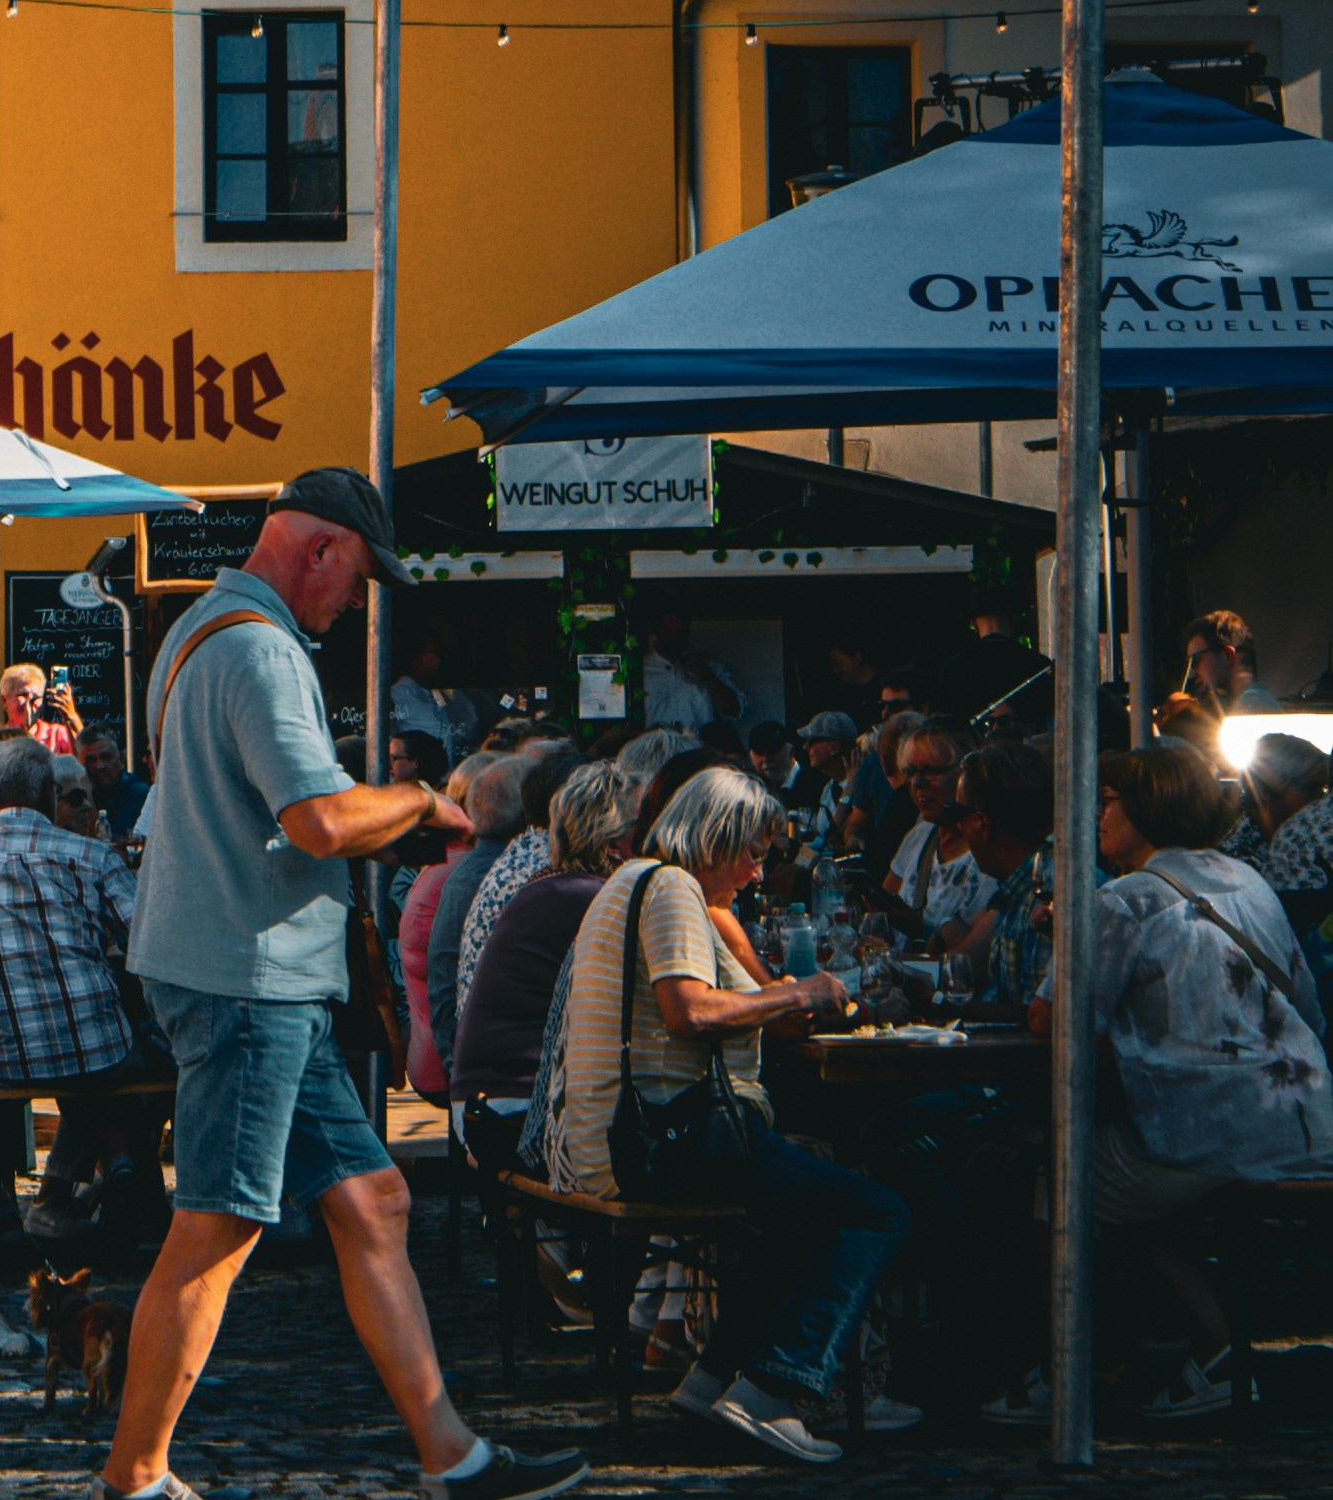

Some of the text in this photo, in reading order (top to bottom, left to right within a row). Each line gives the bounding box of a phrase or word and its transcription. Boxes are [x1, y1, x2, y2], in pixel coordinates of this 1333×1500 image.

[989, 320, 1333, 333] MINRALQUELLEN
[499, 478, 708, 506] WEINGUT SCHUH
[154, 541, 256, 560] Kräuterschman
[34, 608, 123, 626] TAGESANGEB
